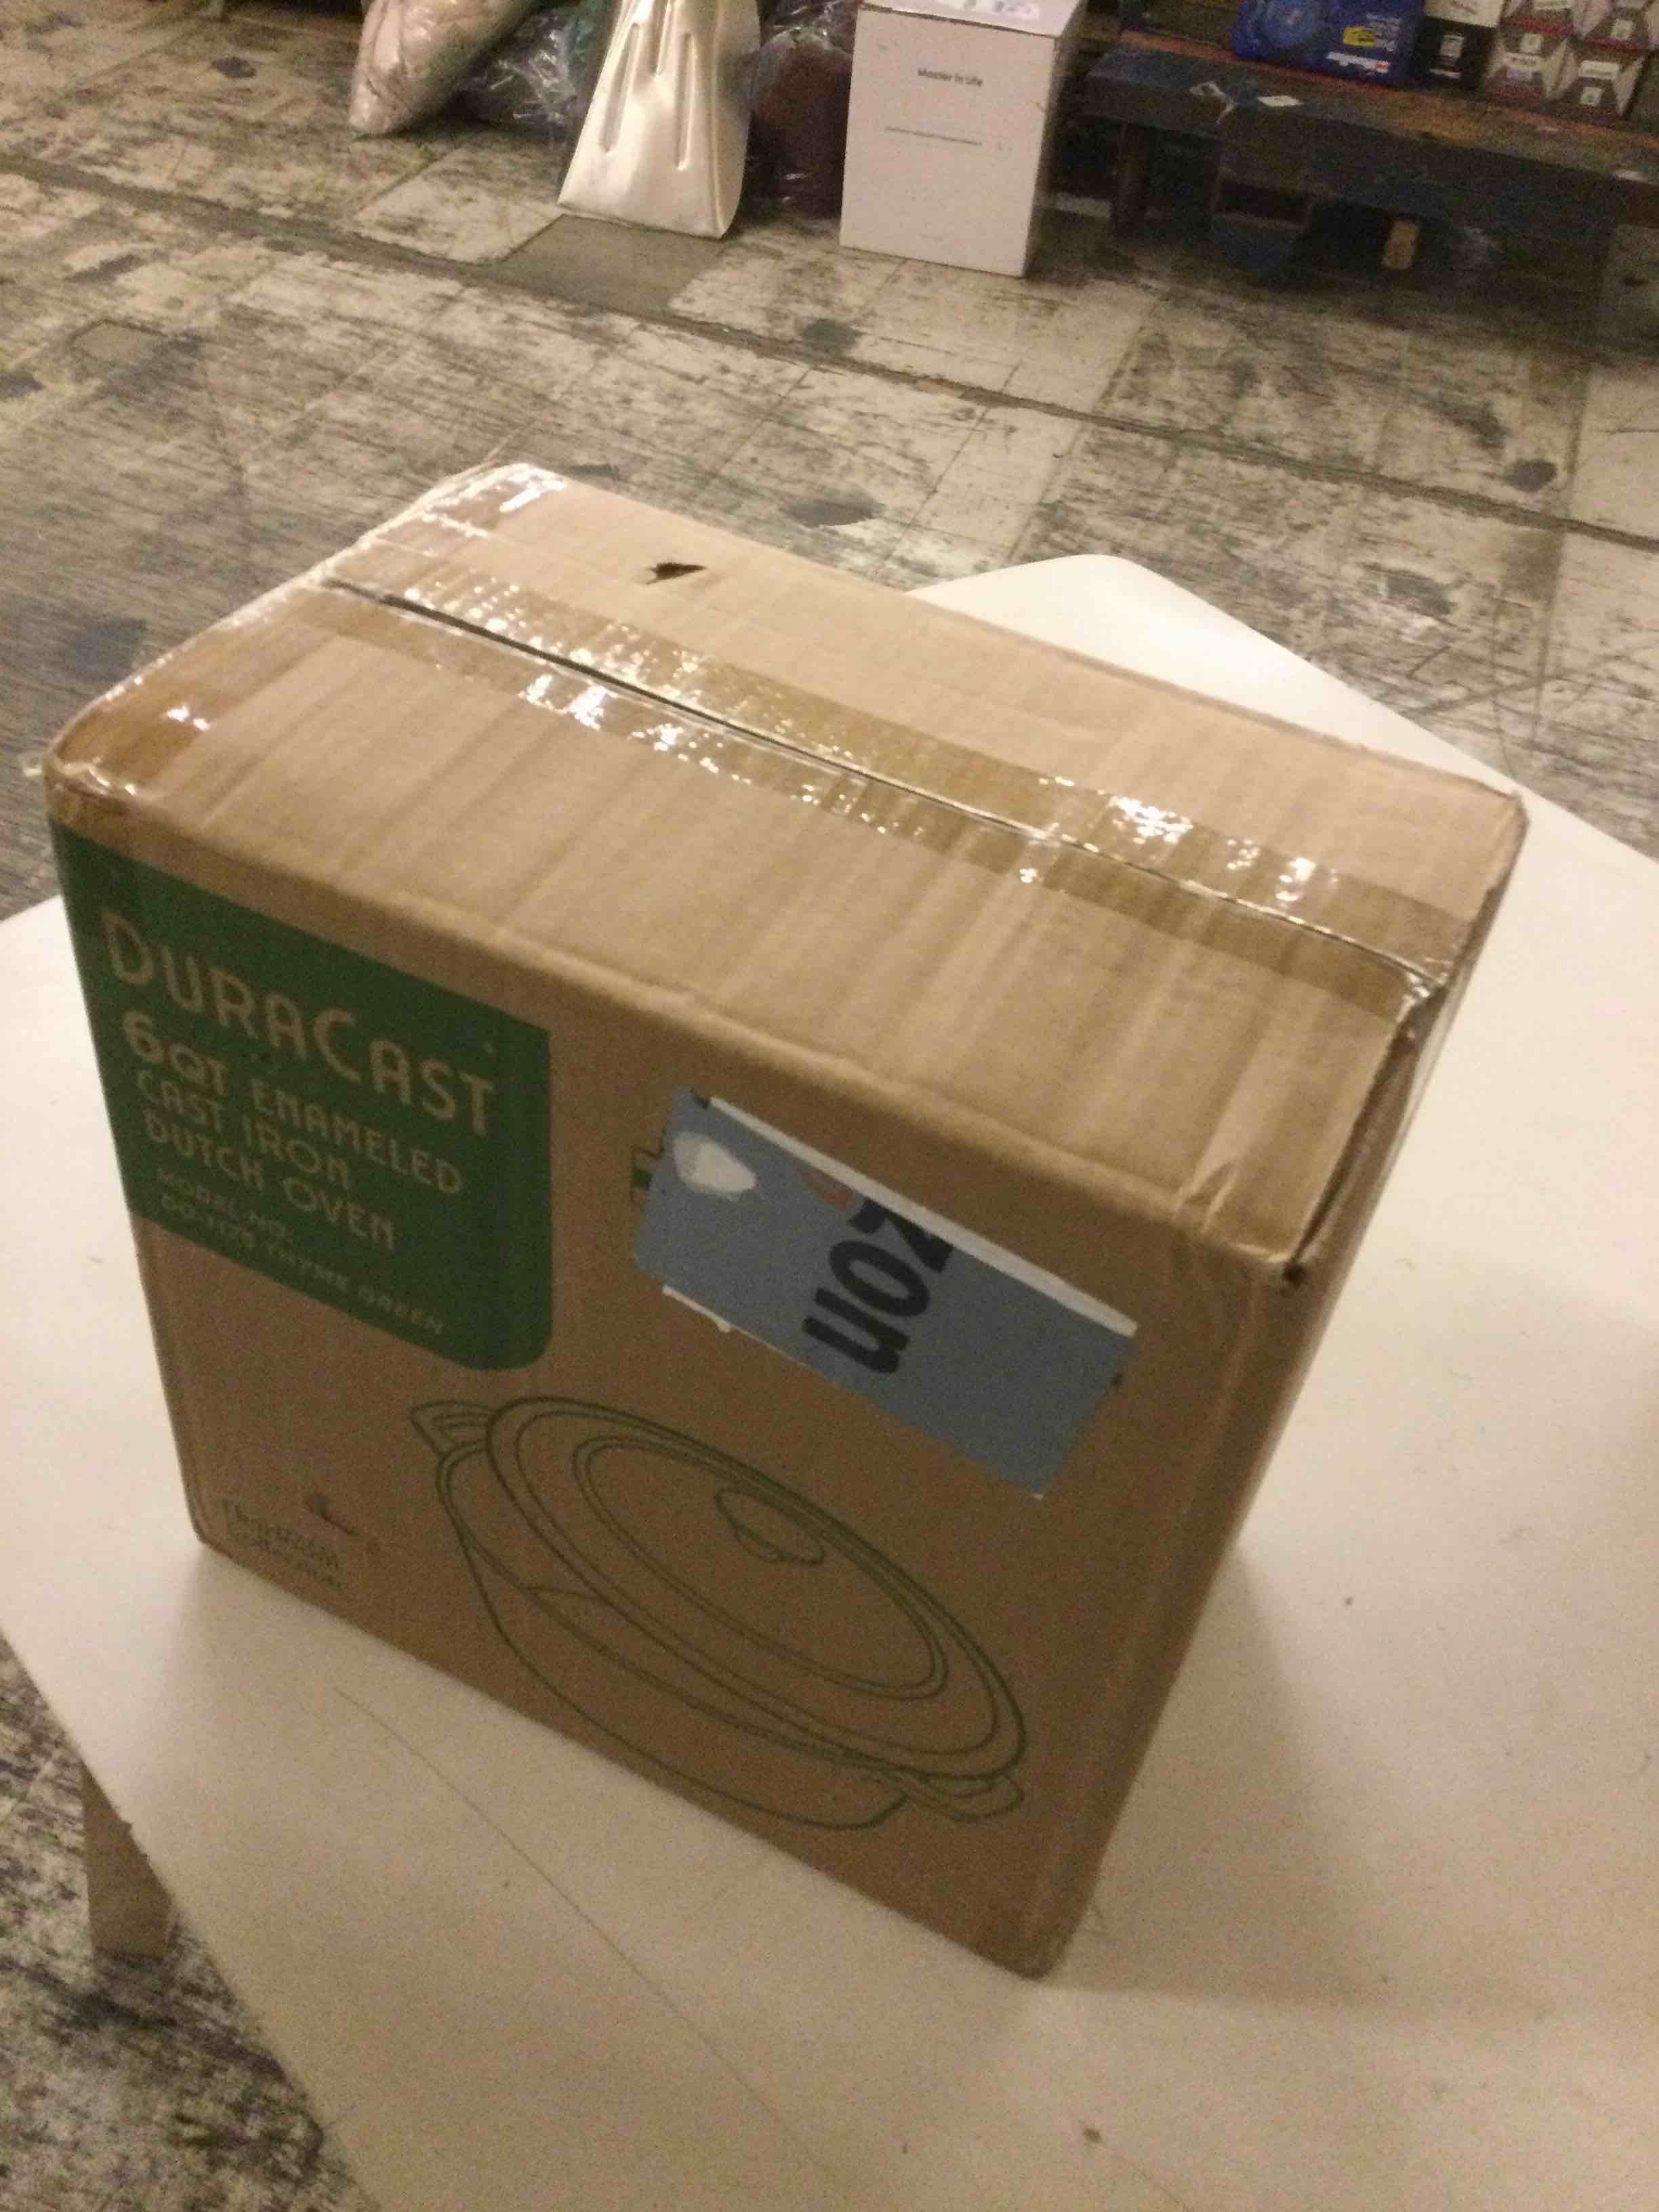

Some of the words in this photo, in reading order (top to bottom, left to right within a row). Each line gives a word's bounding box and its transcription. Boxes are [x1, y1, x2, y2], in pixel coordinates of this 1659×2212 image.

[138, 1069, 223, 1132] CAST
[243, 1118, 351, 1190] IRON
[142, 1109, 264, 1191] DUTCH
[284, 1179, 396, 1250] OVEN
[252, 1080, 464, 1193] ENAMELED
